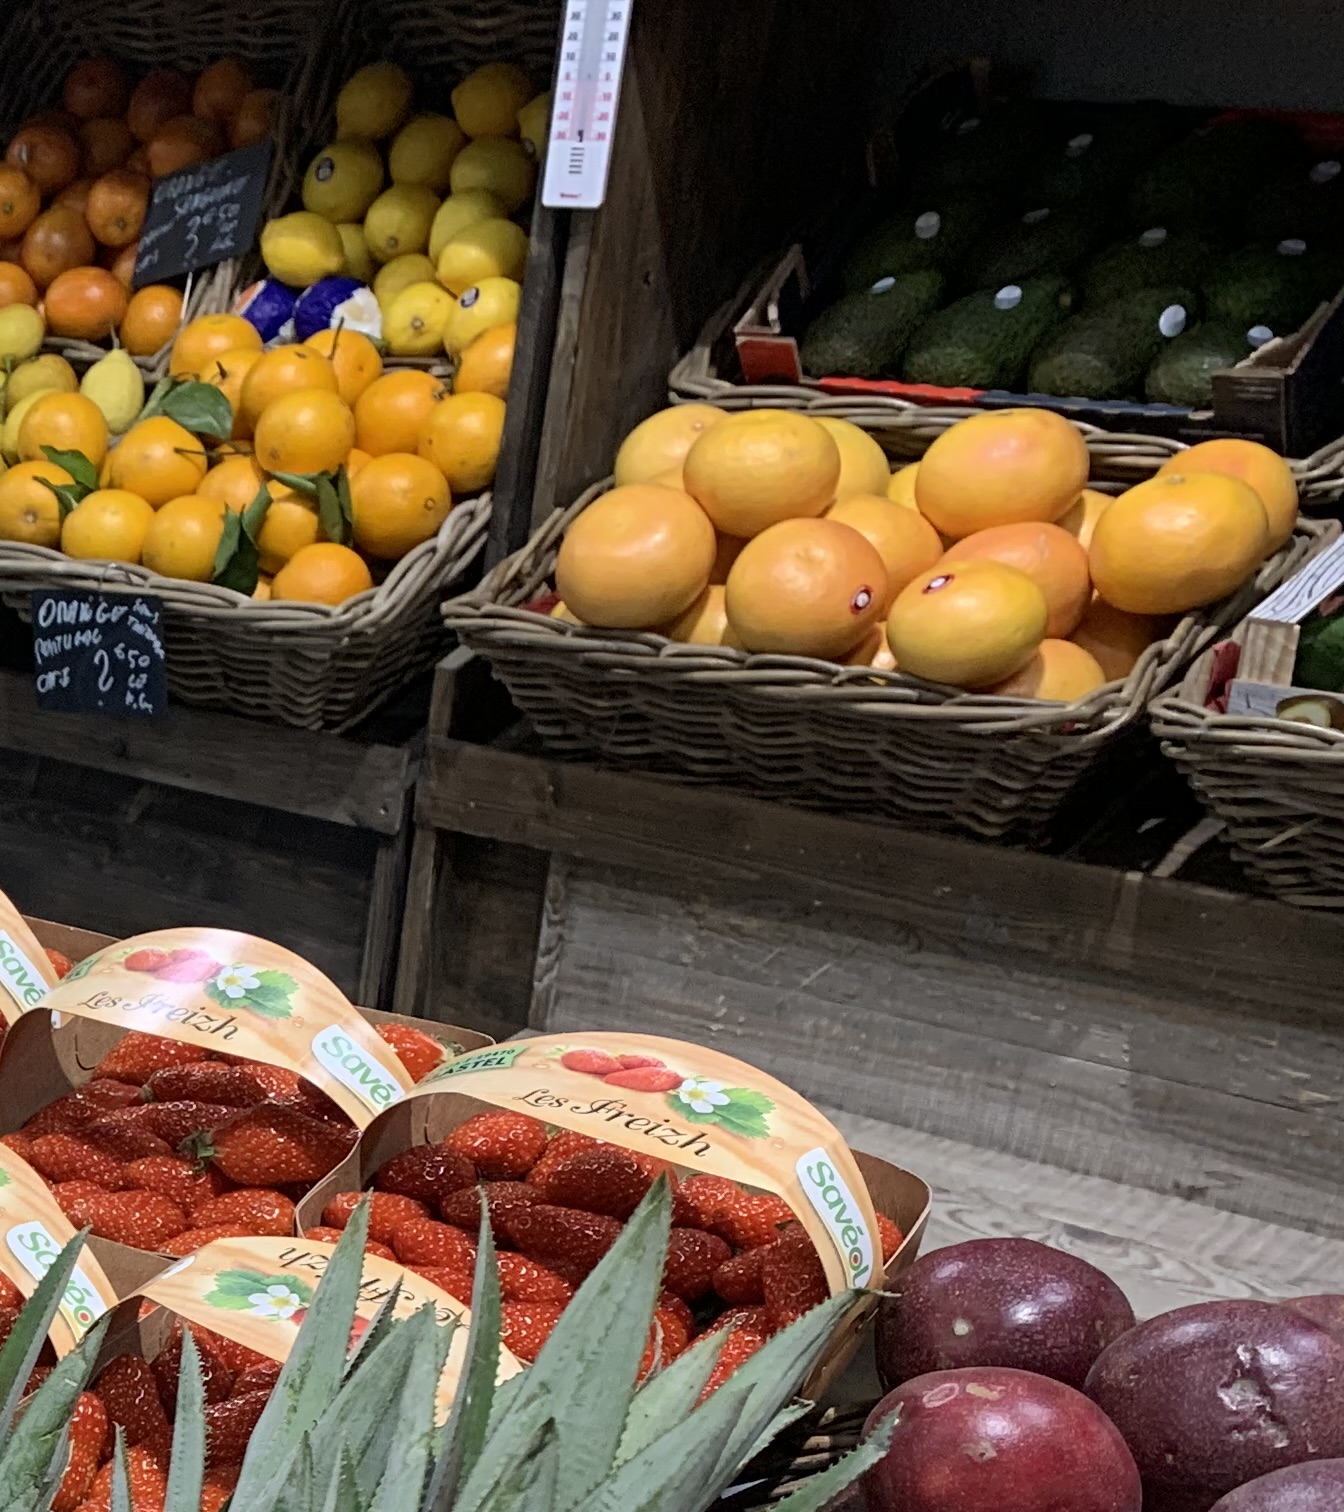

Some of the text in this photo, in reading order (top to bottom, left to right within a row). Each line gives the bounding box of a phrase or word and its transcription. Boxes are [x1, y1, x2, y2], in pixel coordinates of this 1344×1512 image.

[77, 990, 240, 1041] Les Freizh
[321, 1035, 397, 1110] Savé
[512, 1087, 712, 1158] Les Freizh
